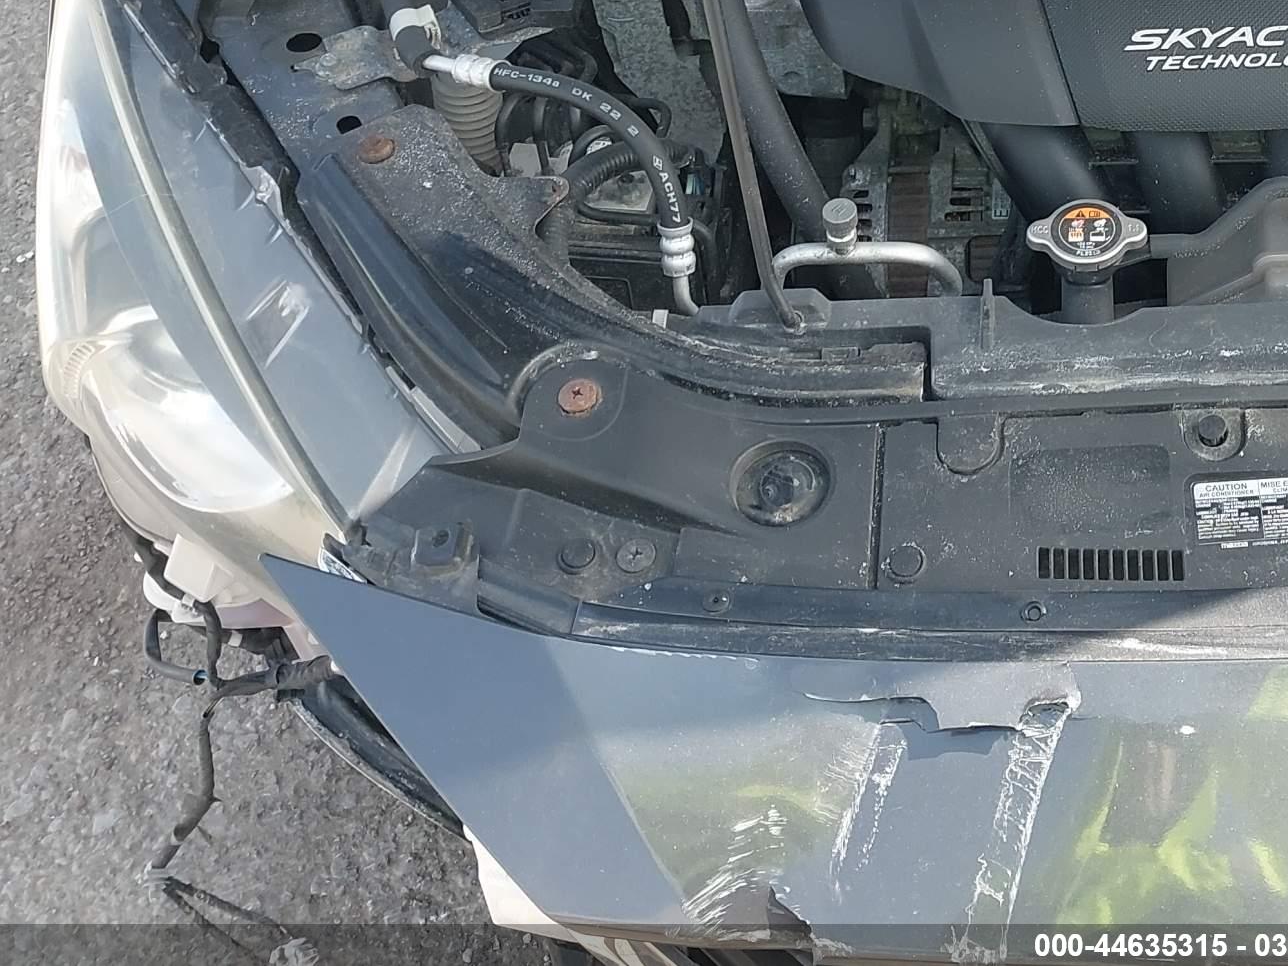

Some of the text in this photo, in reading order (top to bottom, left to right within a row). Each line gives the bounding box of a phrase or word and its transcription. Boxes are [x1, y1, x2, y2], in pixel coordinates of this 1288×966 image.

[571, 87, 593, 102] DK
[599, 102, 622, 122] 22
[626, 124, 640, 137] 2
[658, 172, 682, 223] ACH77
[1205, 482, 1248, 492] CAUTION
[1260, 480, 1281, 489] MISE
